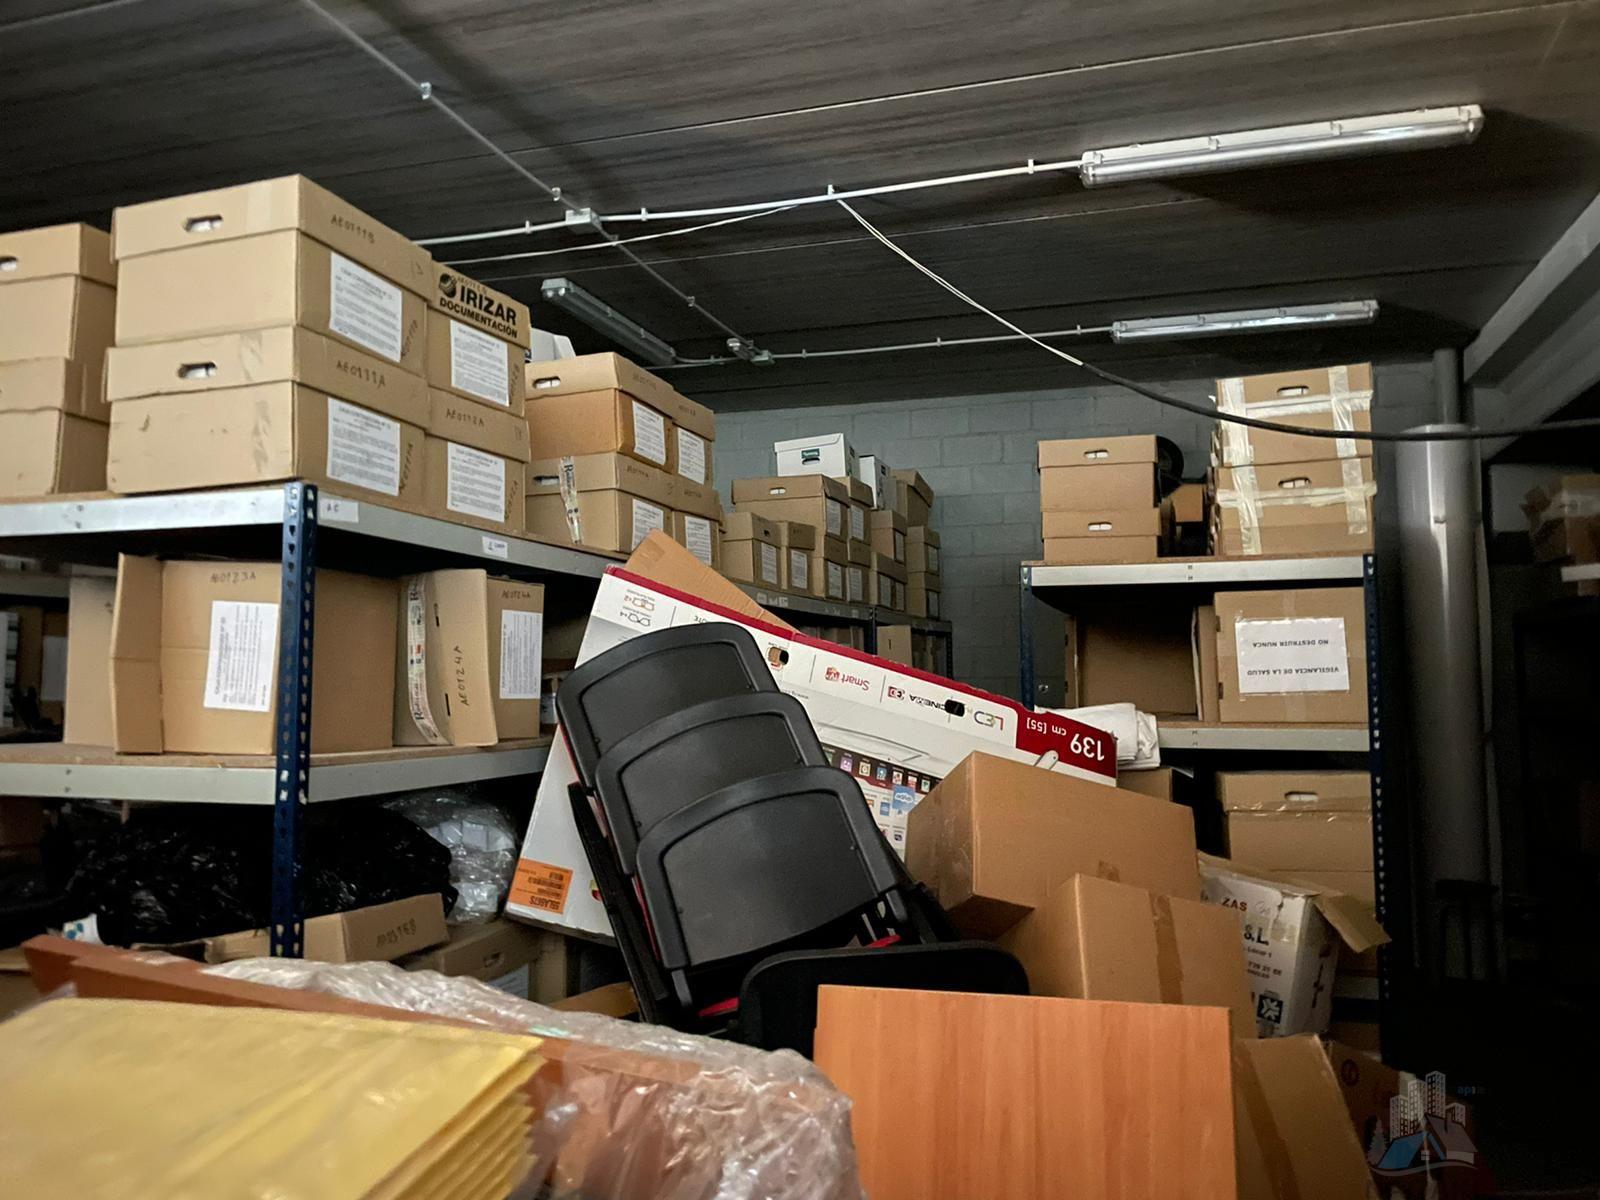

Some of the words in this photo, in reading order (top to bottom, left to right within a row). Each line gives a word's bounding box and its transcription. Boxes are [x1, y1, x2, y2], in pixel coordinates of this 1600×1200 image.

[460, 286, 517, 325] IRIZAR
[439, 297, 518, 339] DOCUMENTACIÓN
[1279, 639, 1316, 647] DESTRUIR
[1294, 666, 1339, 674] VIGILANCIA
[841, 673, 870, 692] Smart
[974, 710, 1004, 731] LED
[1051, 724, 1067, 737] cm
[1069, 732, 1106, 762] 139
[1222, 897, 1248, 912] ZAS
